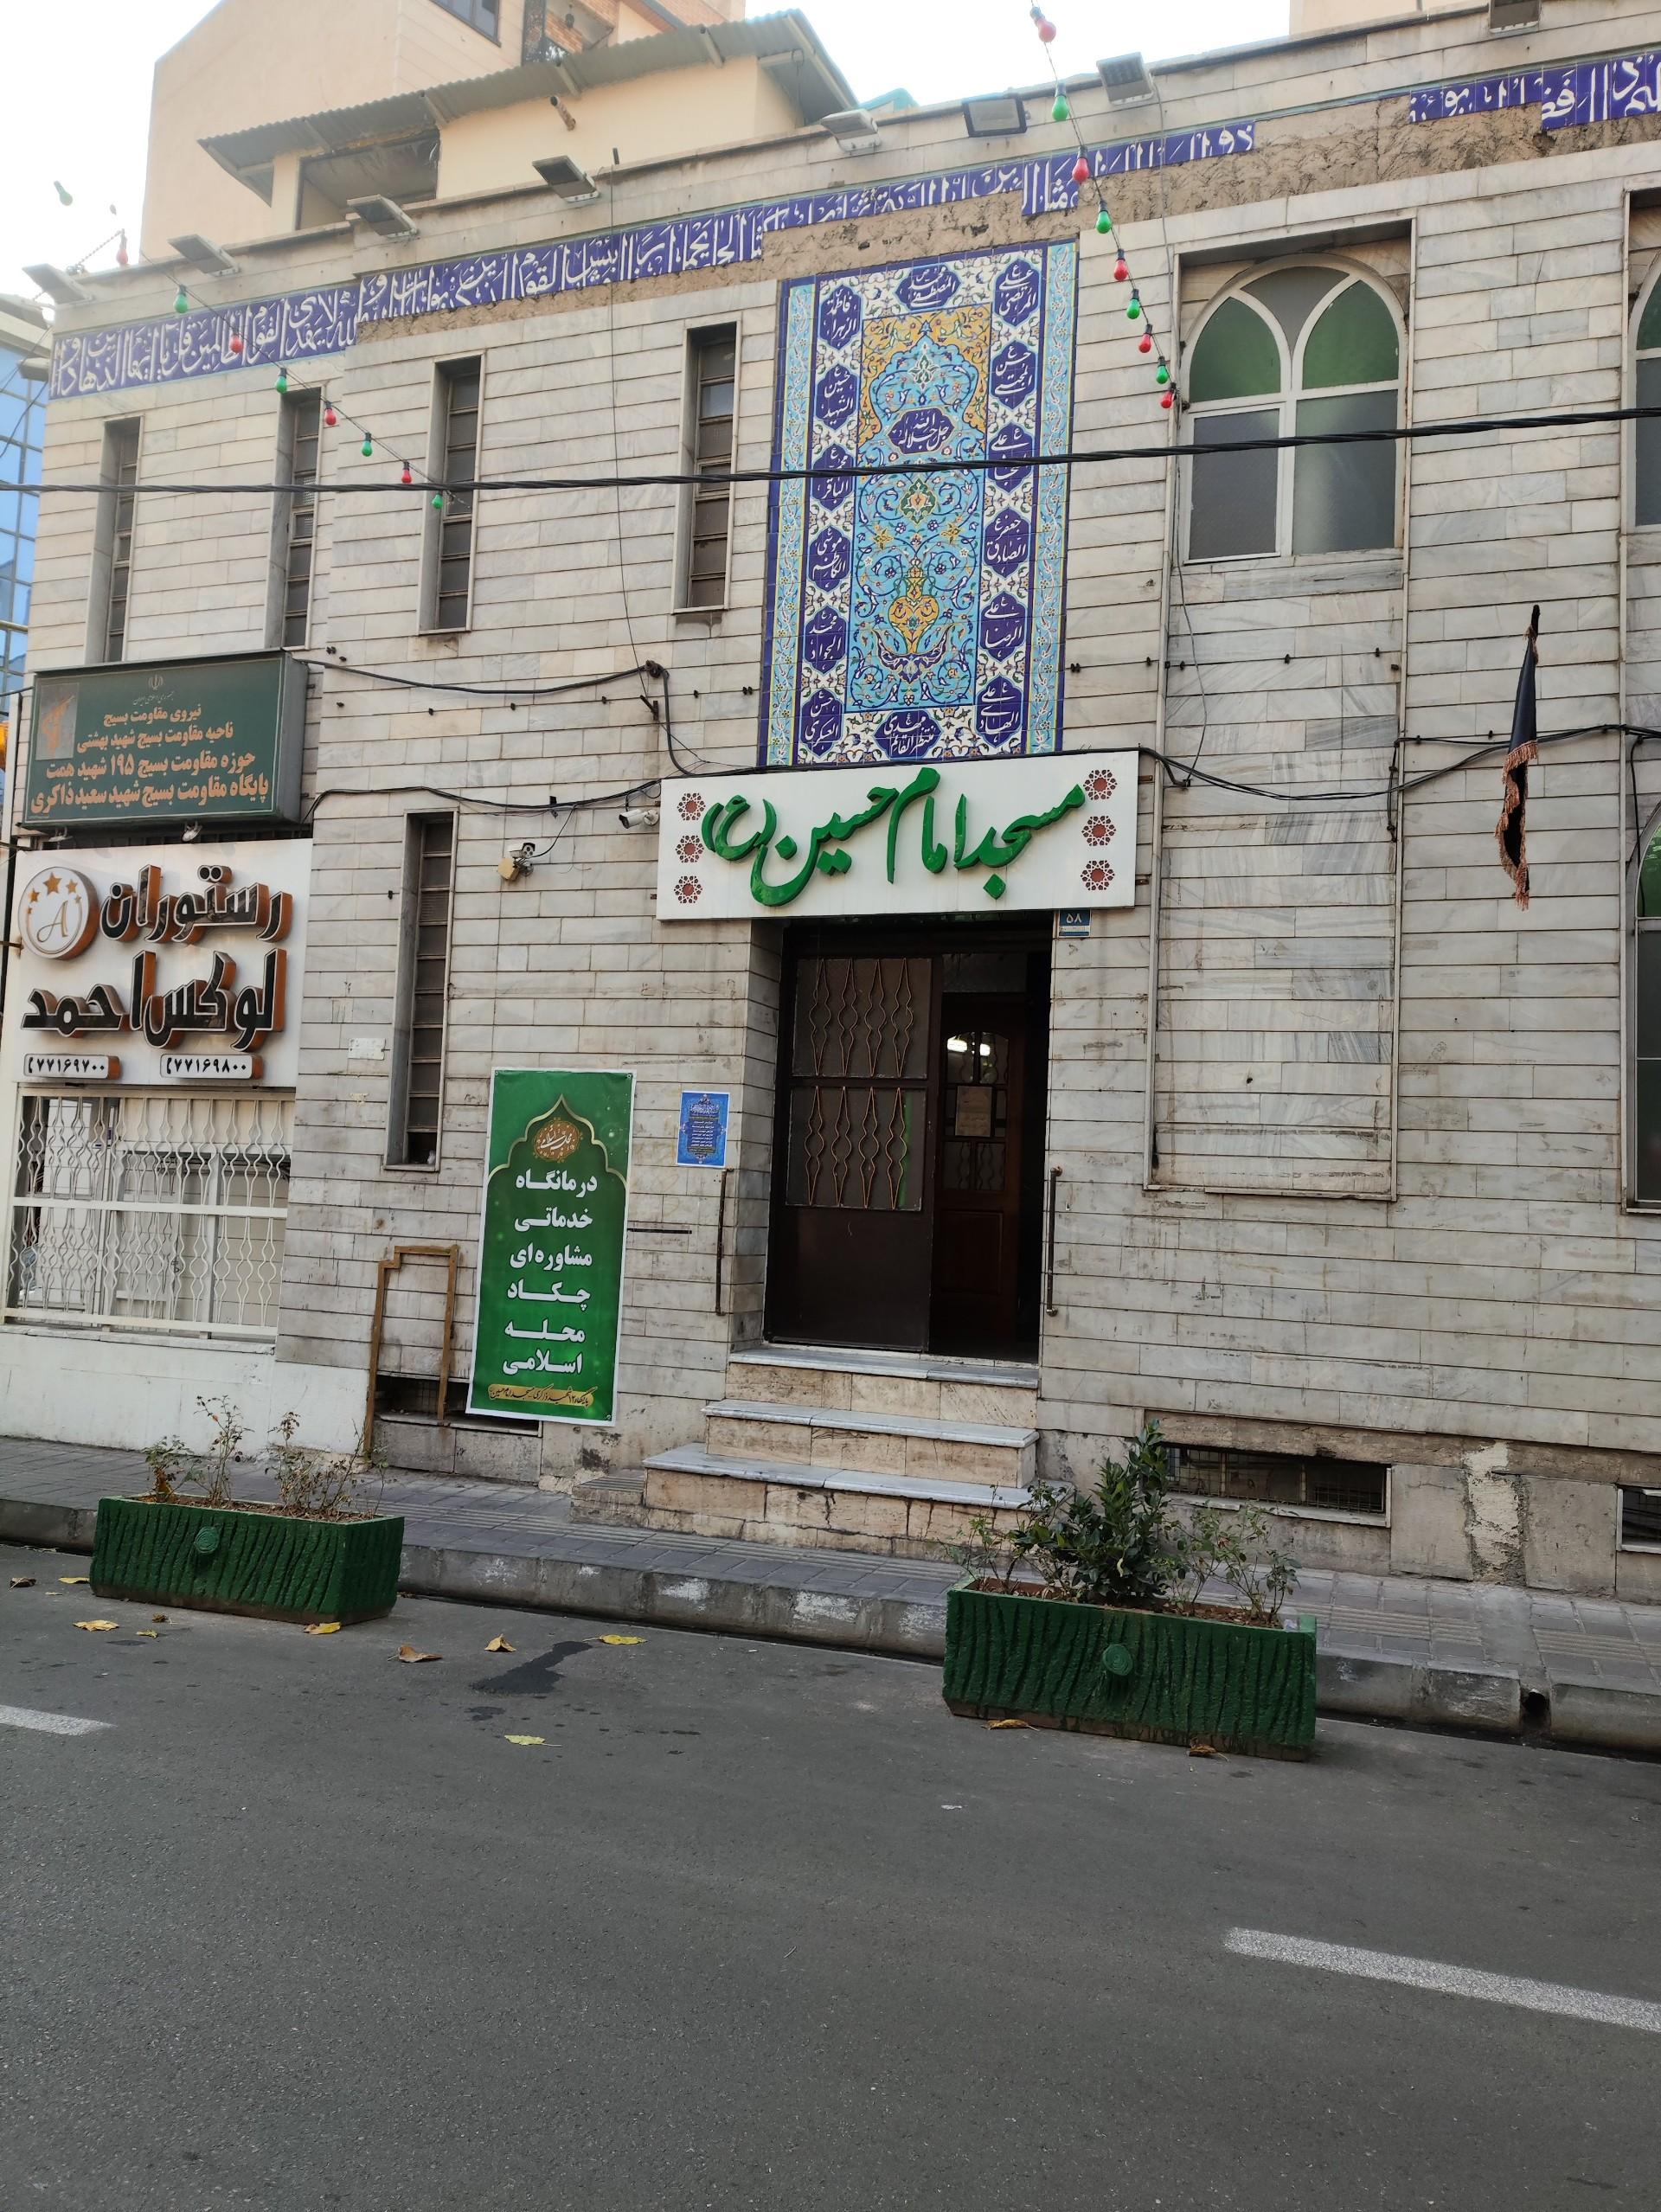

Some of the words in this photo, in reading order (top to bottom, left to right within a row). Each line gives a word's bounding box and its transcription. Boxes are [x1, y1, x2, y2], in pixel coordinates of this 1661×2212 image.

[103, 711, 128, 728] بسیج
[131, 706, 167, 725] مقاومت
[170, 704, 202, 722] نیروی
[77, 731, 108, 753] بهشتی
[110, 729, 135, 747] شهید
[137, 731, 163, 749] بسیج
[164, 725, 203, 747] مقاومت
[206, 721, 234, 741] ناحیه
[46, 760, 74, 780] همت
[77, 757, 107, 781] شهید
[138, 755, 169, 779] بسیج
[170, 749, 217, 776] مقاومت
[221, 750, 256, 774] حوزه
[30, 783, 74, 815] ذاکری
[75, 785, 107, 811] سعید
[108, 780, 141, 810] شهید
[141, 783, 175, 808] بسیج
[176, 776, 227, 806] مقاومت
[229, 773, 269, 804] پایگاه
[887, 767, 967, 884] امام
[750, 785, 901, 907] حسین
[953, 784, 1087, 901] مسجد
[100, 864, 292, 943] رستوران
[1066, 913, 1082, 924] ۵۸
[20, 949, 157, 1037] احمد
[143, 947, 287, 1052] لوکس
[36, 1056, 106, 1074] ۷۷۱۶۹۷۰۰
[174, 1056, 247, 1074] ۷۷۱۶۹۸۰۰
[516, 1169, 598, 1198] درمانگاه
[514, 1206, 593, 1232] خدماتی
[507, 1279, 591, 1311] چکاد
[504, 1319, 585, 1343] محله
[503, 1349, 582, 1375] اسلامی
